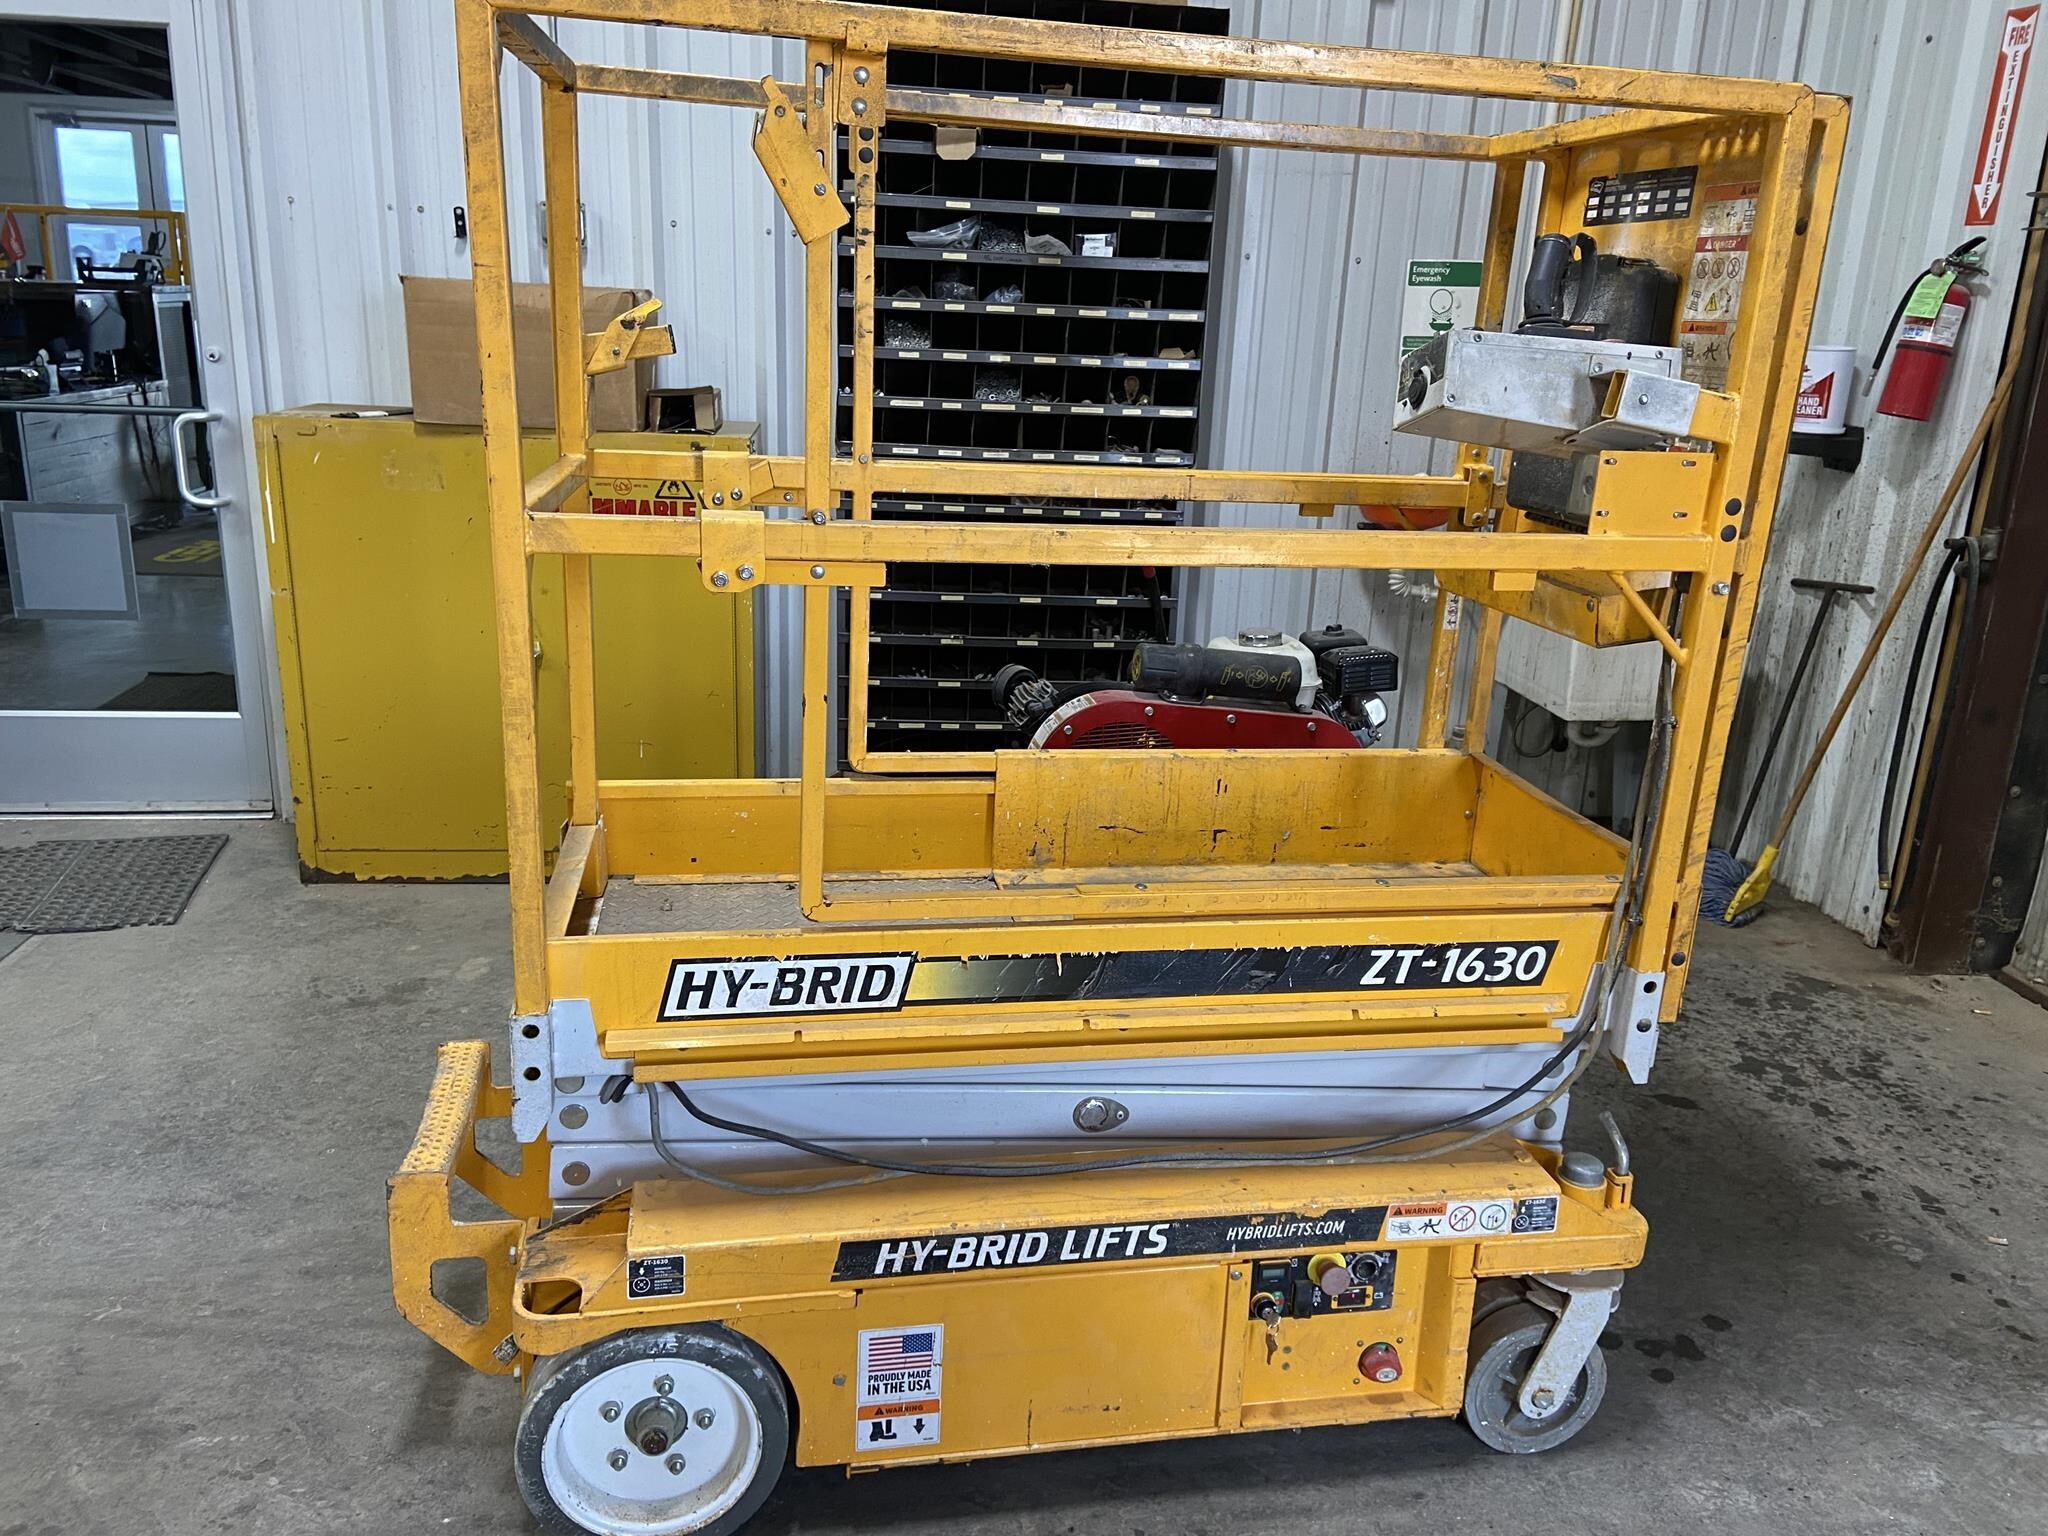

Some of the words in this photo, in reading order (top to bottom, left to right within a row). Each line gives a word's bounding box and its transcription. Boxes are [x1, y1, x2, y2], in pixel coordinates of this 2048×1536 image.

[2008, 24, 2032, 47] FIRE
[1981, 50, 2020, 209] EXTINGUISHER
[1412, 265, 1451, 275] Emergency
[1412, 275, 1442, 283] Eyewash
[1798, 396, 1820, 406] HAND
[1796, 405, 1823, 415] EANER
[592, 498, 697, 517] MMABLE
[1359, 945, 1547, 985] ZT-1630
[675, 964, 896, 1011] HY-BRID
[1404, 1206, 1444, 1216] WARNING
[1226, 1220, 1346, 1241] HYBRIDLIFTS.COM
[873, 1232, 1048, 1275] HY-BRID
[1060, 1223, 1170, 1261] LIFTS
[868, 1371, 906, 1383] PROUDLY
[907, 1369, 932, 1379] MADE
[867, 1382, 880, 1396] IN
[883, 1381, 905, 1394] THE
[908, 1379, 932, 1392] USA
[885, 1404, 924, 1414] WARNING
